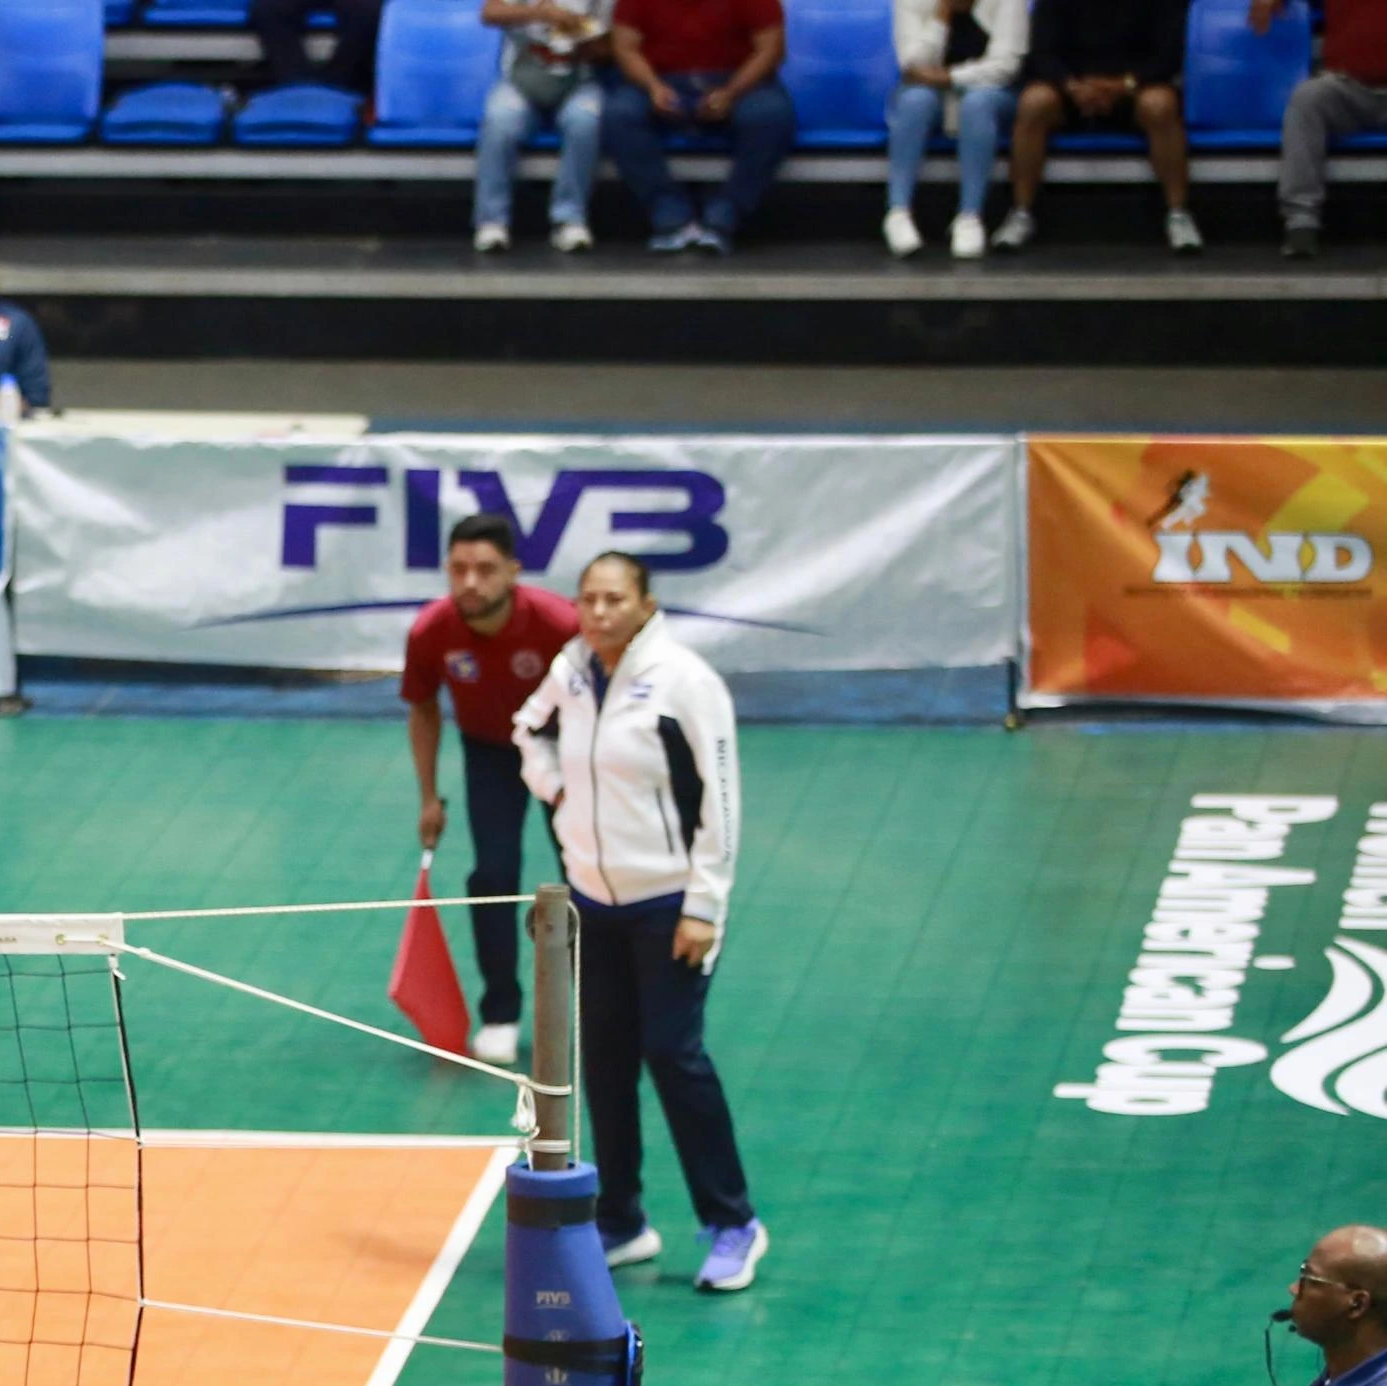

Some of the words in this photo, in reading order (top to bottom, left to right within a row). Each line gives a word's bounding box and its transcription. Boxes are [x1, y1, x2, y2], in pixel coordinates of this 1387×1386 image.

[279, 465, 731, 573] FIVB
[1172, 793, 1339, 861] Pan
[1052, 1032, 1269, 1116] Cup
